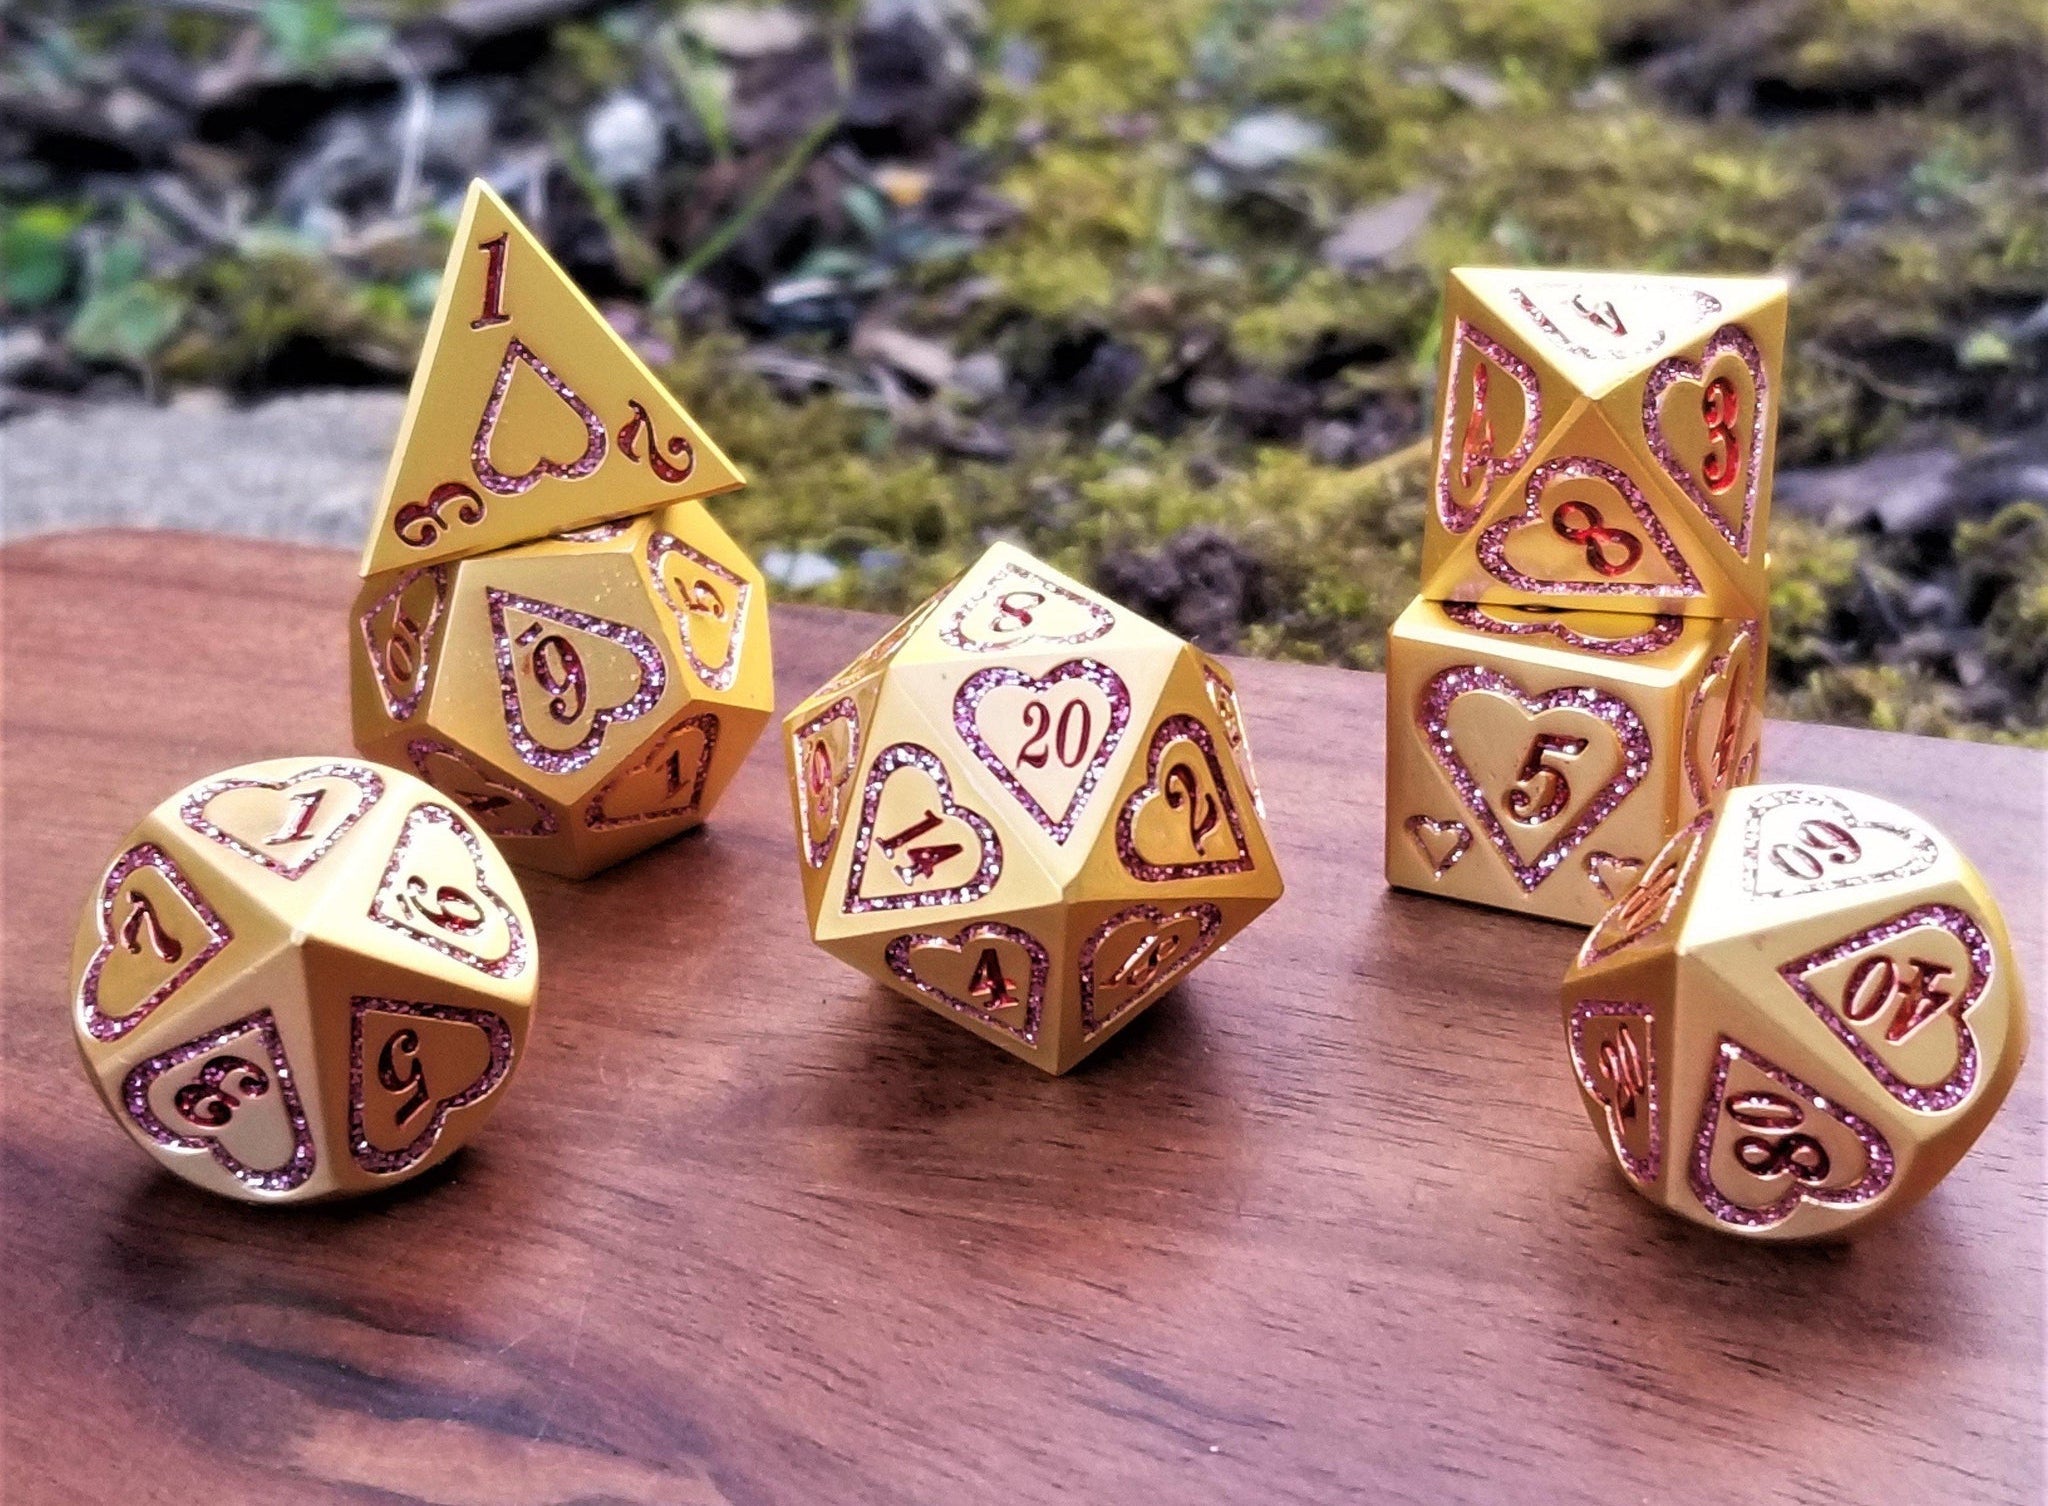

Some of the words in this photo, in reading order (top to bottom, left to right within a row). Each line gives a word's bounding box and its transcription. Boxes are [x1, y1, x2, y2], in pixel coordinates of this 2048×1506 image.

[471, 232, 511, 331] 1
[617, 399, 696, 484] 2
[1702, 376, 1741, 496] 3
[393, 481, 487, 548] 3
[1552, 500, 1643, 577] 8
[988, 590, 1046, 633] 8
[1016, 699, 1092, 770] 20
[654, 749, 692, 799] 1
[1164, 762, 1216, 857] 2
[1505, 732, 1589, 828] 5
[265, 788, 327, 847] 1
[875, 810, 963, 886] 14
[120, 890, 182, 964] 7
[967, 947, 1020, 1011] 4
[1841, 953, 1956, 1048] 40
[174, 1054, 271, 1128] 3
[377, 1028, 430, 1127] 5
[1725, 1087, 1831, 1185] 80
